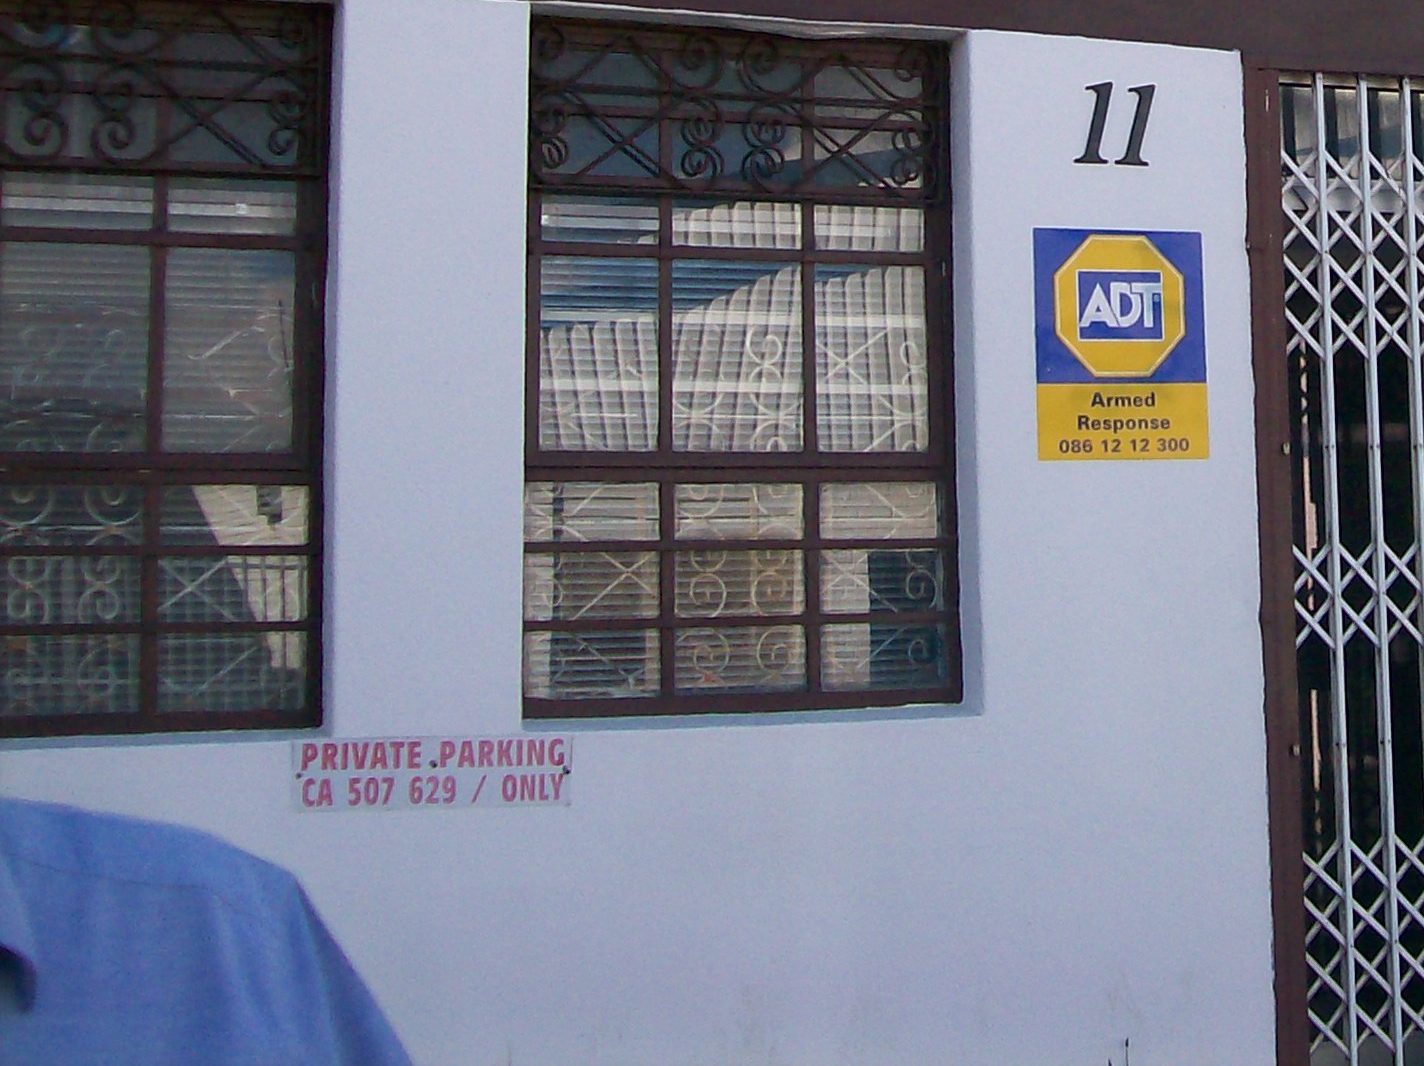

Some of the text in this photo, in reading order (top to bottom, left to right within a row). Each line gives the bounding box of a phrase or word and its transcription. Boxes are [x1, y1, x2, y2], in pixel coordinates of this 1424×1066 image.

[1073, 81, 1156, 167] 11
[1078, 281, 1162, 328] ADT
[1090, 391, 1156, 408] Armed
[1076, 414, 1171, 434] Response
[1058, 437, 1190, 454] 086 12 12 300
[301, 738, 565, 772] PRIVATE PARKING
[302, 777, 334, 807] CA
[348, 776, 395, 806] 507
[409, 775, 457, 805] 629
[501, 772, 565, 803] ONLY
